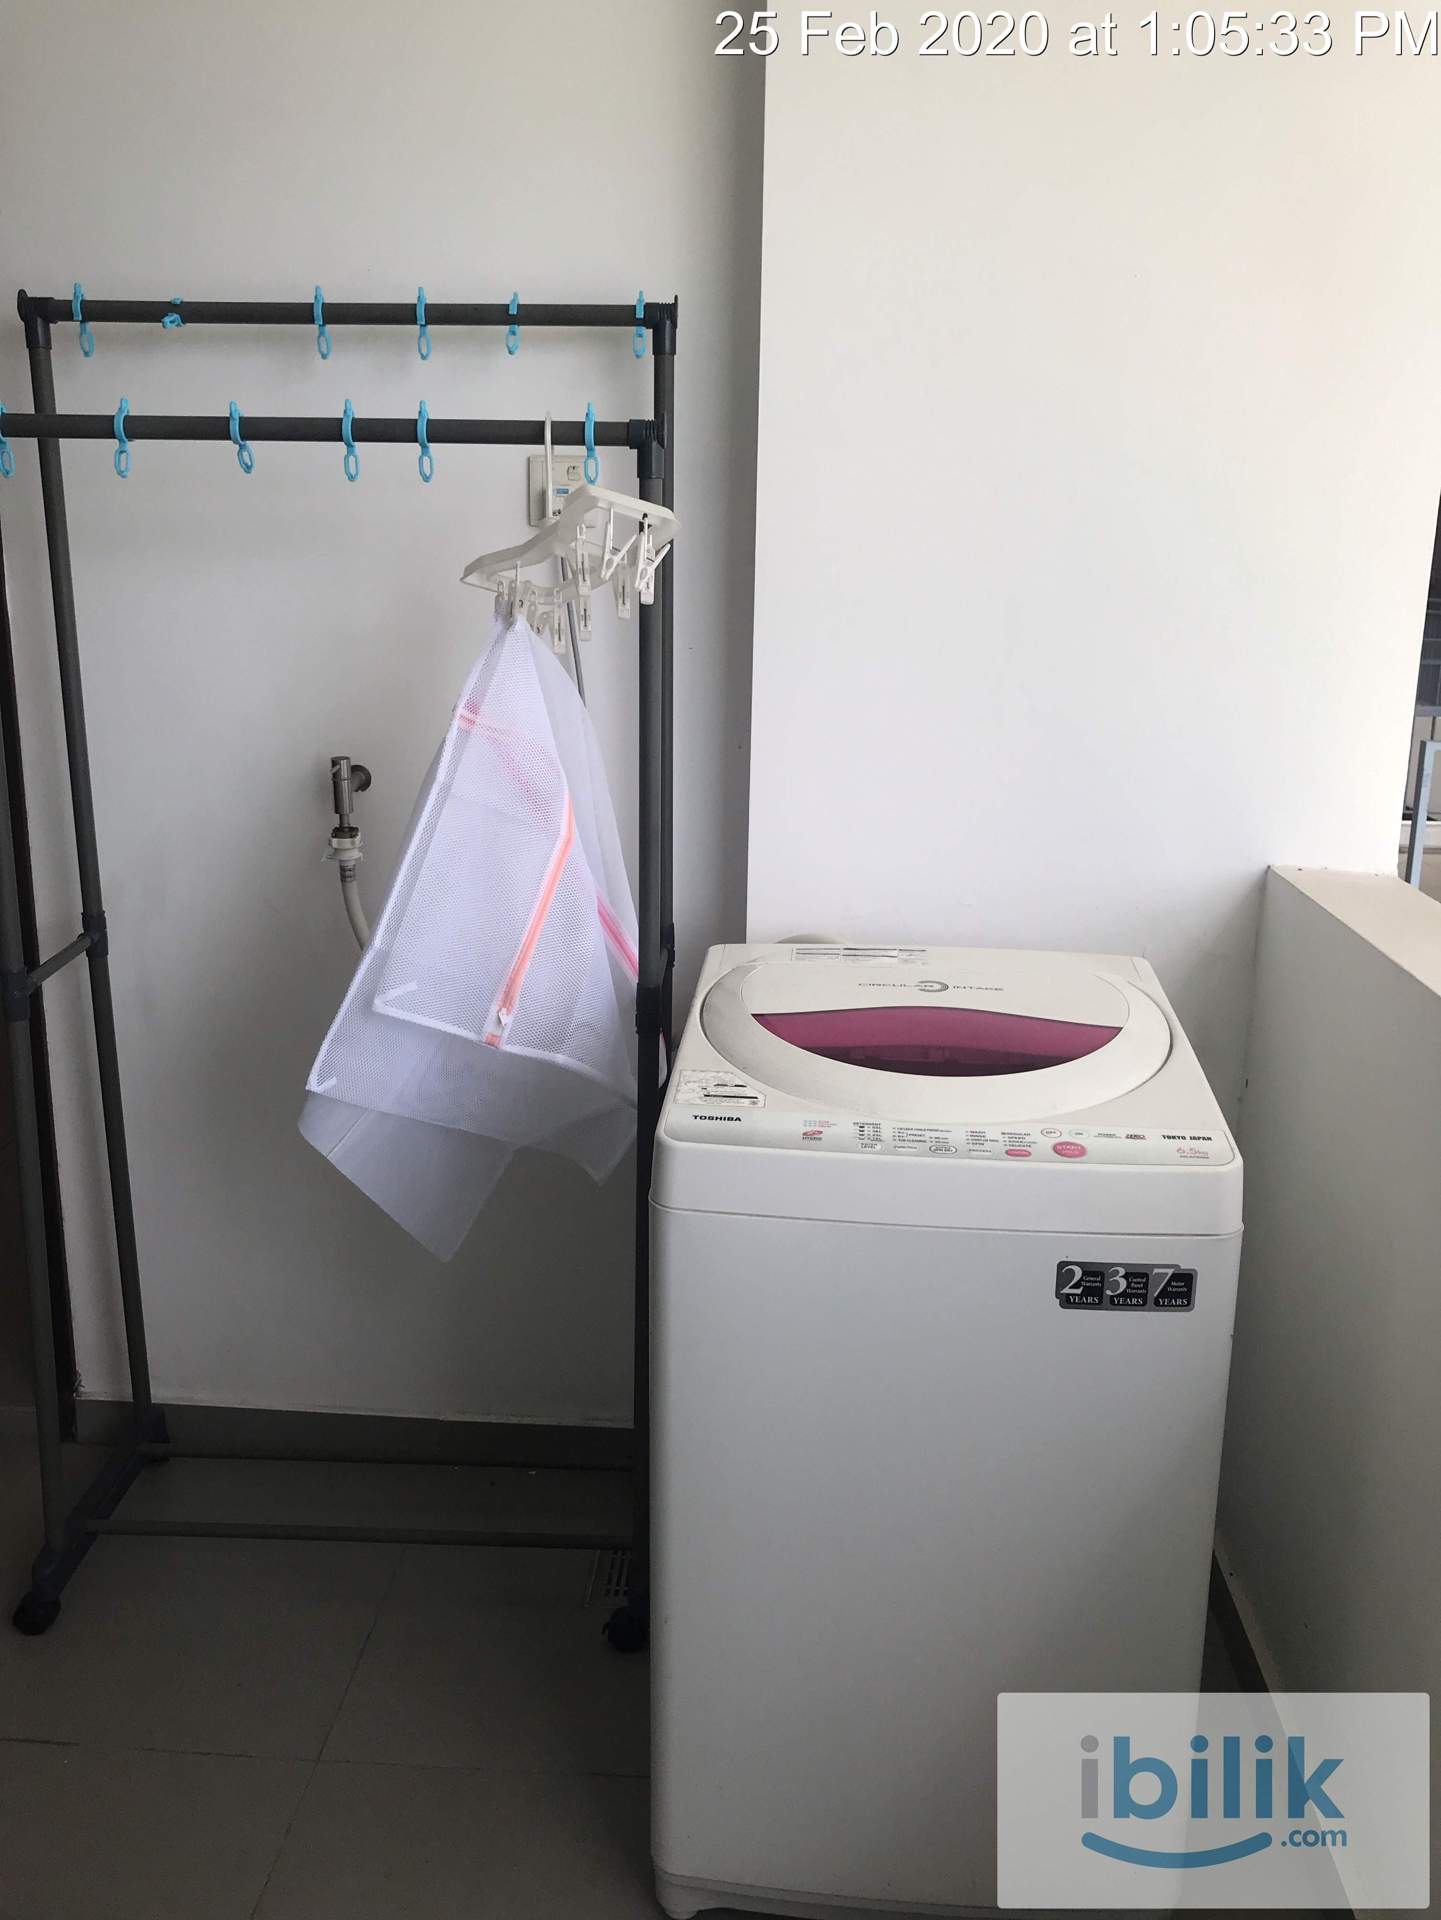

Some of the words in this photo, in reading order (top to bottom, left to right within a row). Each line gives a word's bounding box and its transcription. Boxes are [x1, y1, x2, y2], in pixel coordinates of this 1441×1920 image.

[692, 1114, 742, 1122] TOSHIBA
[1161, 1133, 1187, 1141] TOKYO
[1189, 1134, 1214, 1142] JAPAN
[1060, 1264, 1084, 1294] 2
[1105, 1266, 1127, 1296] 3
[1152, 1268, 1175, 1297] 7
[1069, 1295, 1099, 1304] YEARS
[1113, 1297, 1144, 1305] YEARS
[1158, 1298, 1188, 1306] YEARS
